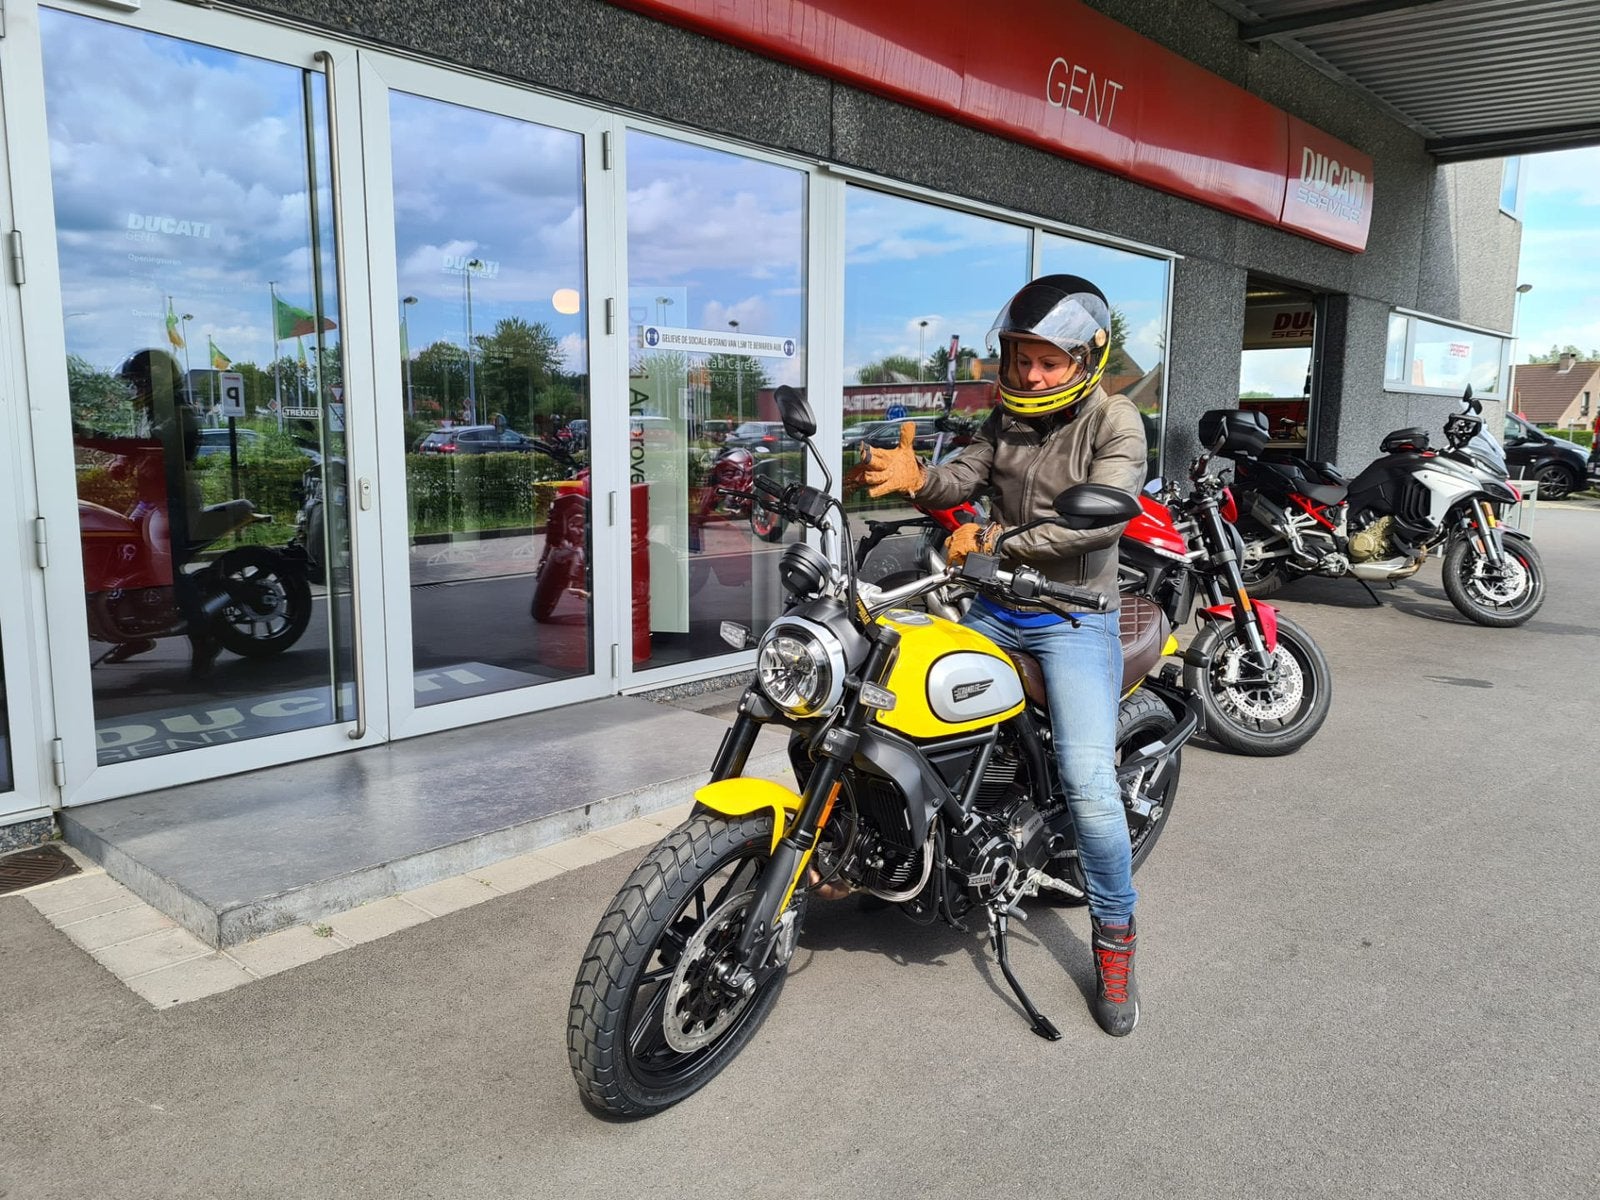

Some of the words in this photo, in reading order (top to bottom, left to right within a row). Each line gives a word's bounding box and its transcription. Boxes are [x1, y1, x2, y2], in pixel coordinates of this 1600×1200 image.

[1047, 56, 1123, 127] GENT
[1301, 146, 1366, 209] DUCATI
[1297, 187, 1361, 224] SERVICE
[128, 213, 213, 238] DUCATI
[442, 256, 500, 274] DUATI
[1273, 311, 1314, 330] DU
[662, 333, 681, 344] GELIEVE
[681, 336, 688, 345] DE
[688, 336, 707, 346] SOCIALE
[285, 408, 321, 417] TREKKEN
[629, 388, 650, 500] Approve
